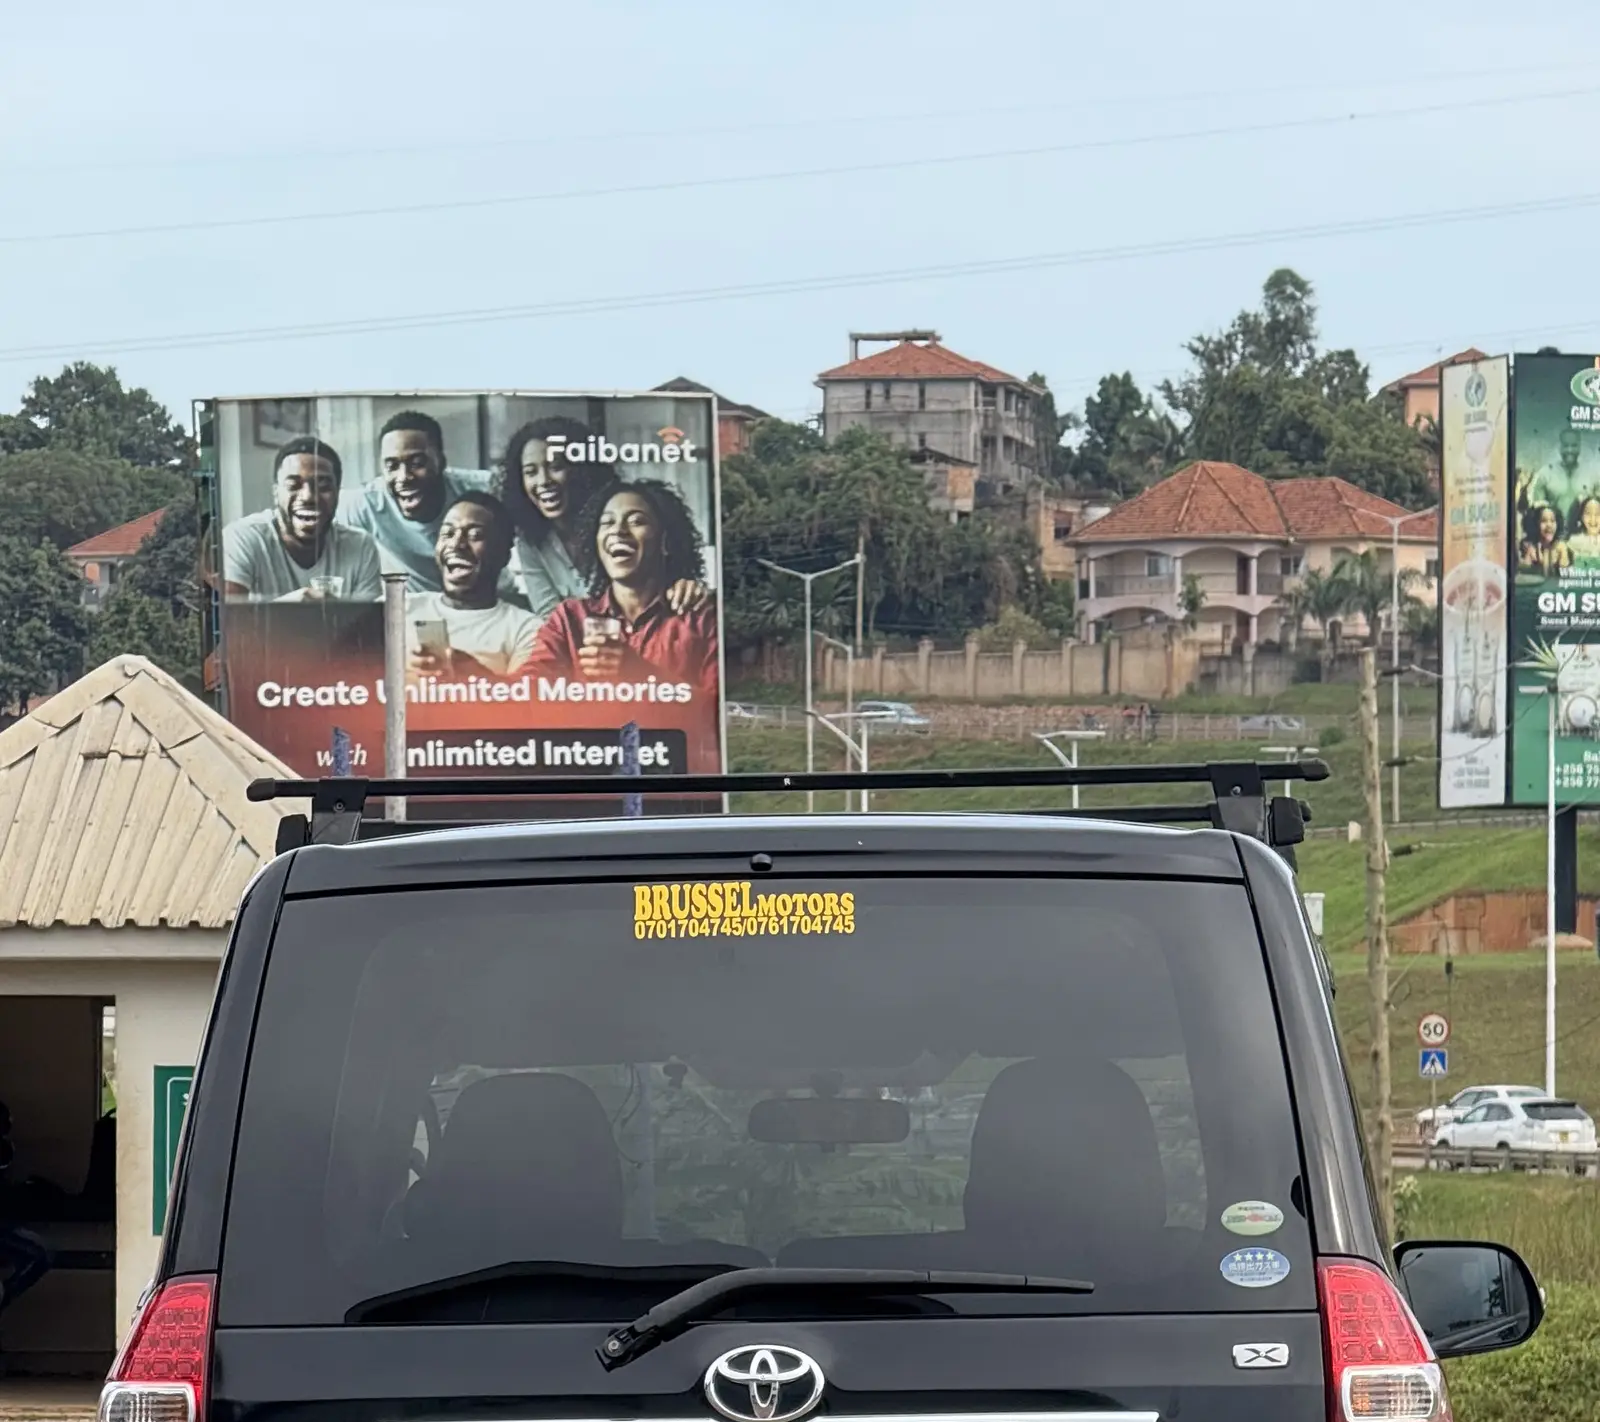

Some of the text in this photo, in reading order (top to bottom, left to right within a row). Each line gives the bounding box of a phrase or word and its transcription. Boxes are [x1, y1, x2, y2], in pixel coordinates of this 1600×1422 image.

[1571, 406, 1590, 420] GM
[546, 435, 697, 463] Faibanet
[1538, 592, 1600, 613] GM S
[257, 681, 369, 707] Create
[538, 675, 692, 703] Memories
[316, 743, 367, 767] wh
[407, 739, 537, 767] nlimited
[634, 881, 855, 921] BRUSSEL MOTORS
[634, 915, 855, 939] 0701704745/0761704745
[1422, 1022, 1444, 1038] 50
